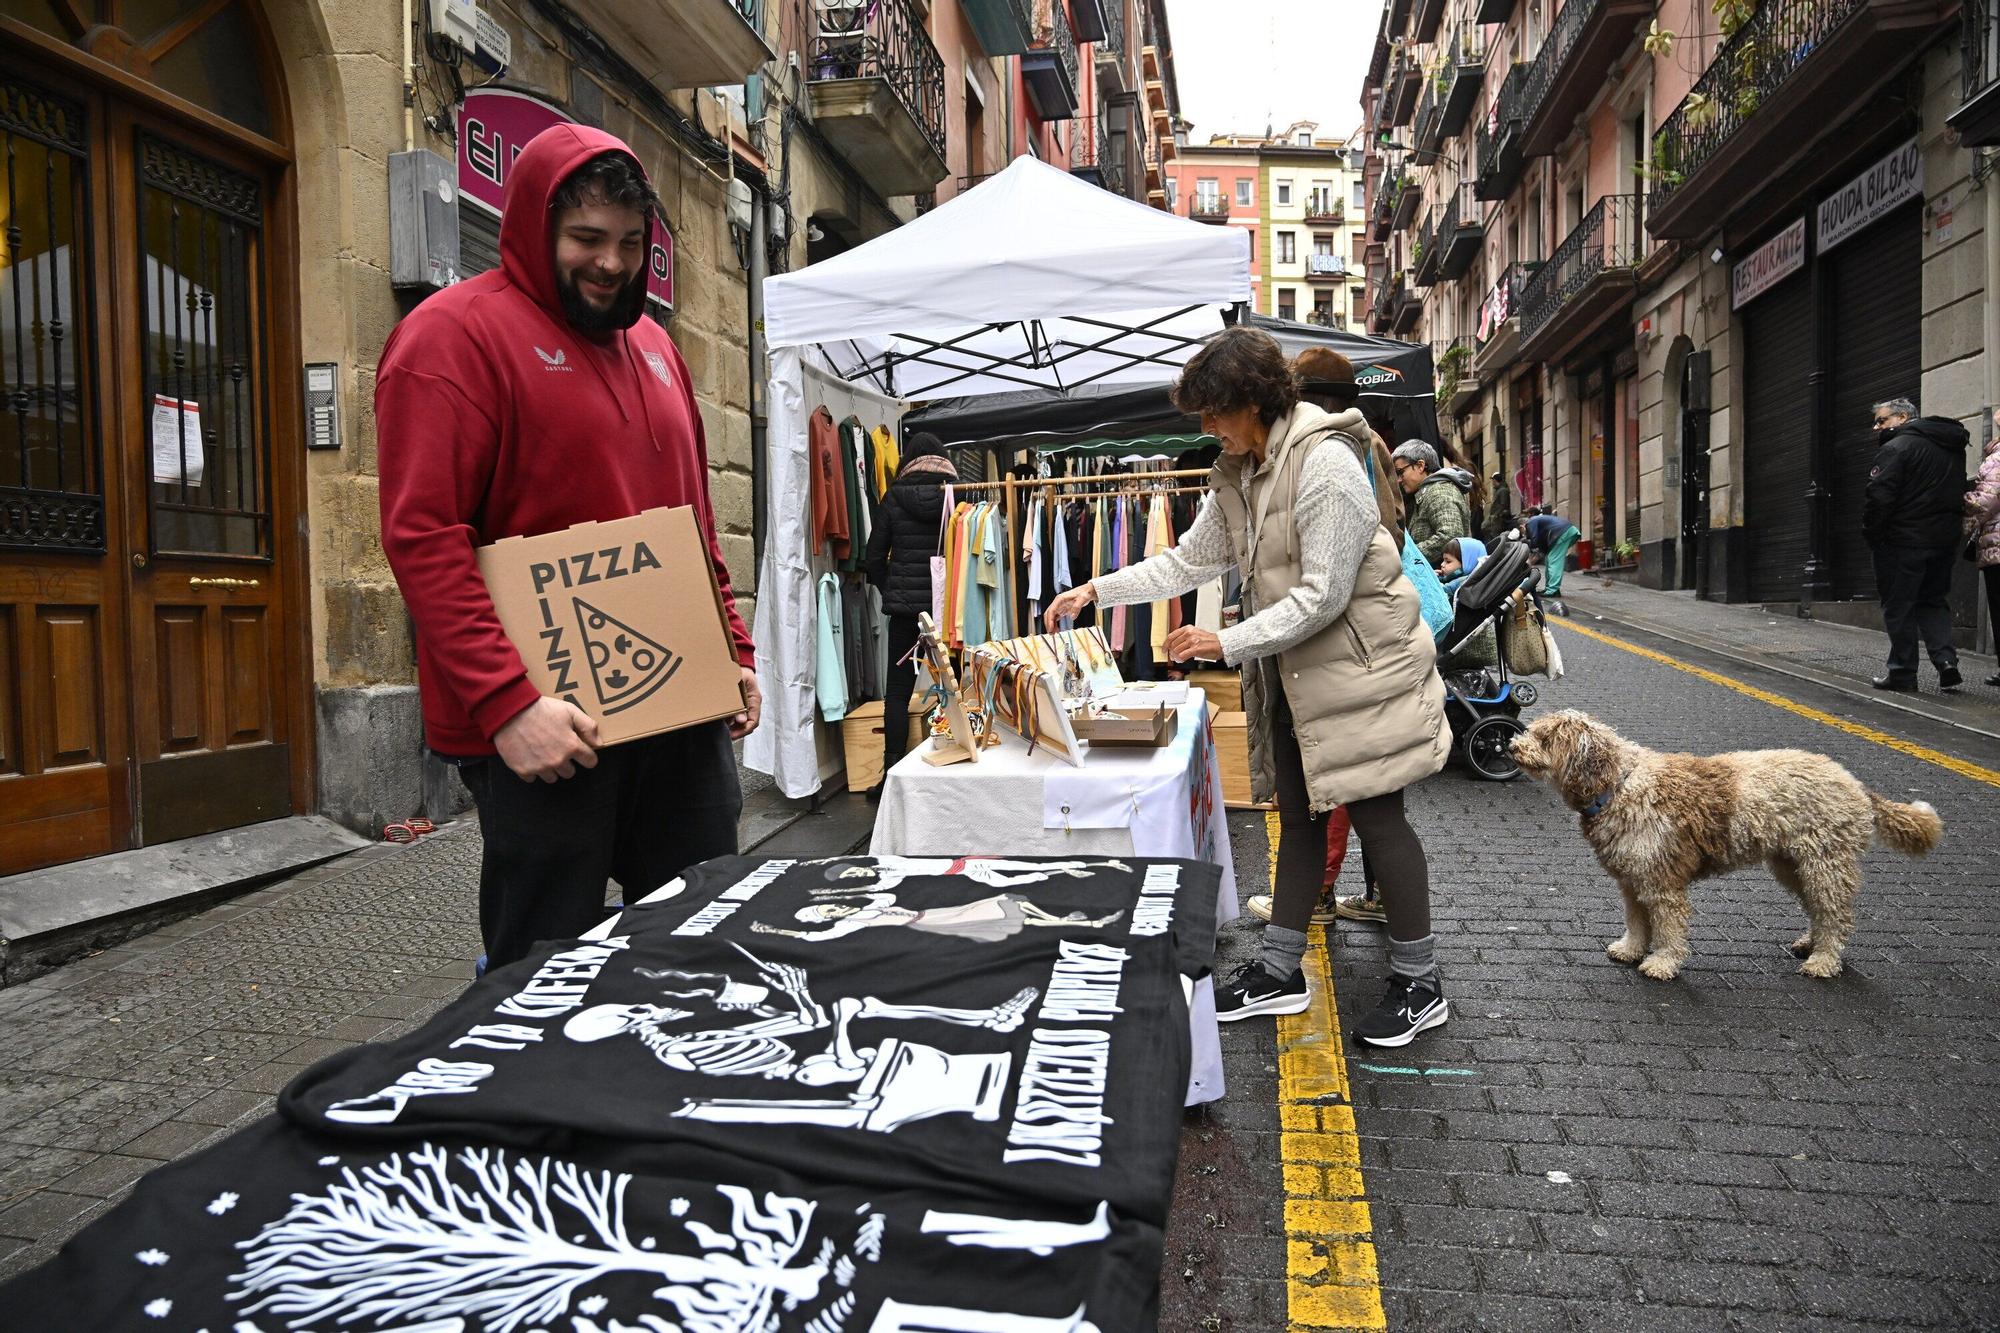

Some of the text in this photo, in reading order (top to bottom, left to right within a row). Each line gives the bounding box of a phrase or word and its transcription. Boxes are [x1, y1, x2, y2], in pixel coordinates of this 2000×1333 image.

[1821, 180, 1863, 238] HOUDA
[1867, 143, 1919, 208] BILBAO
[1827, 215, 1868, 244] MAROKOKO
[1869, 187, 1911, 219] GOZOKIAK
[1735, 222, 1802, 294] RESTAURANTE
[1355, 373, 1396, 385] COBIZI
[530, 541, 662, 594] PIZZA
